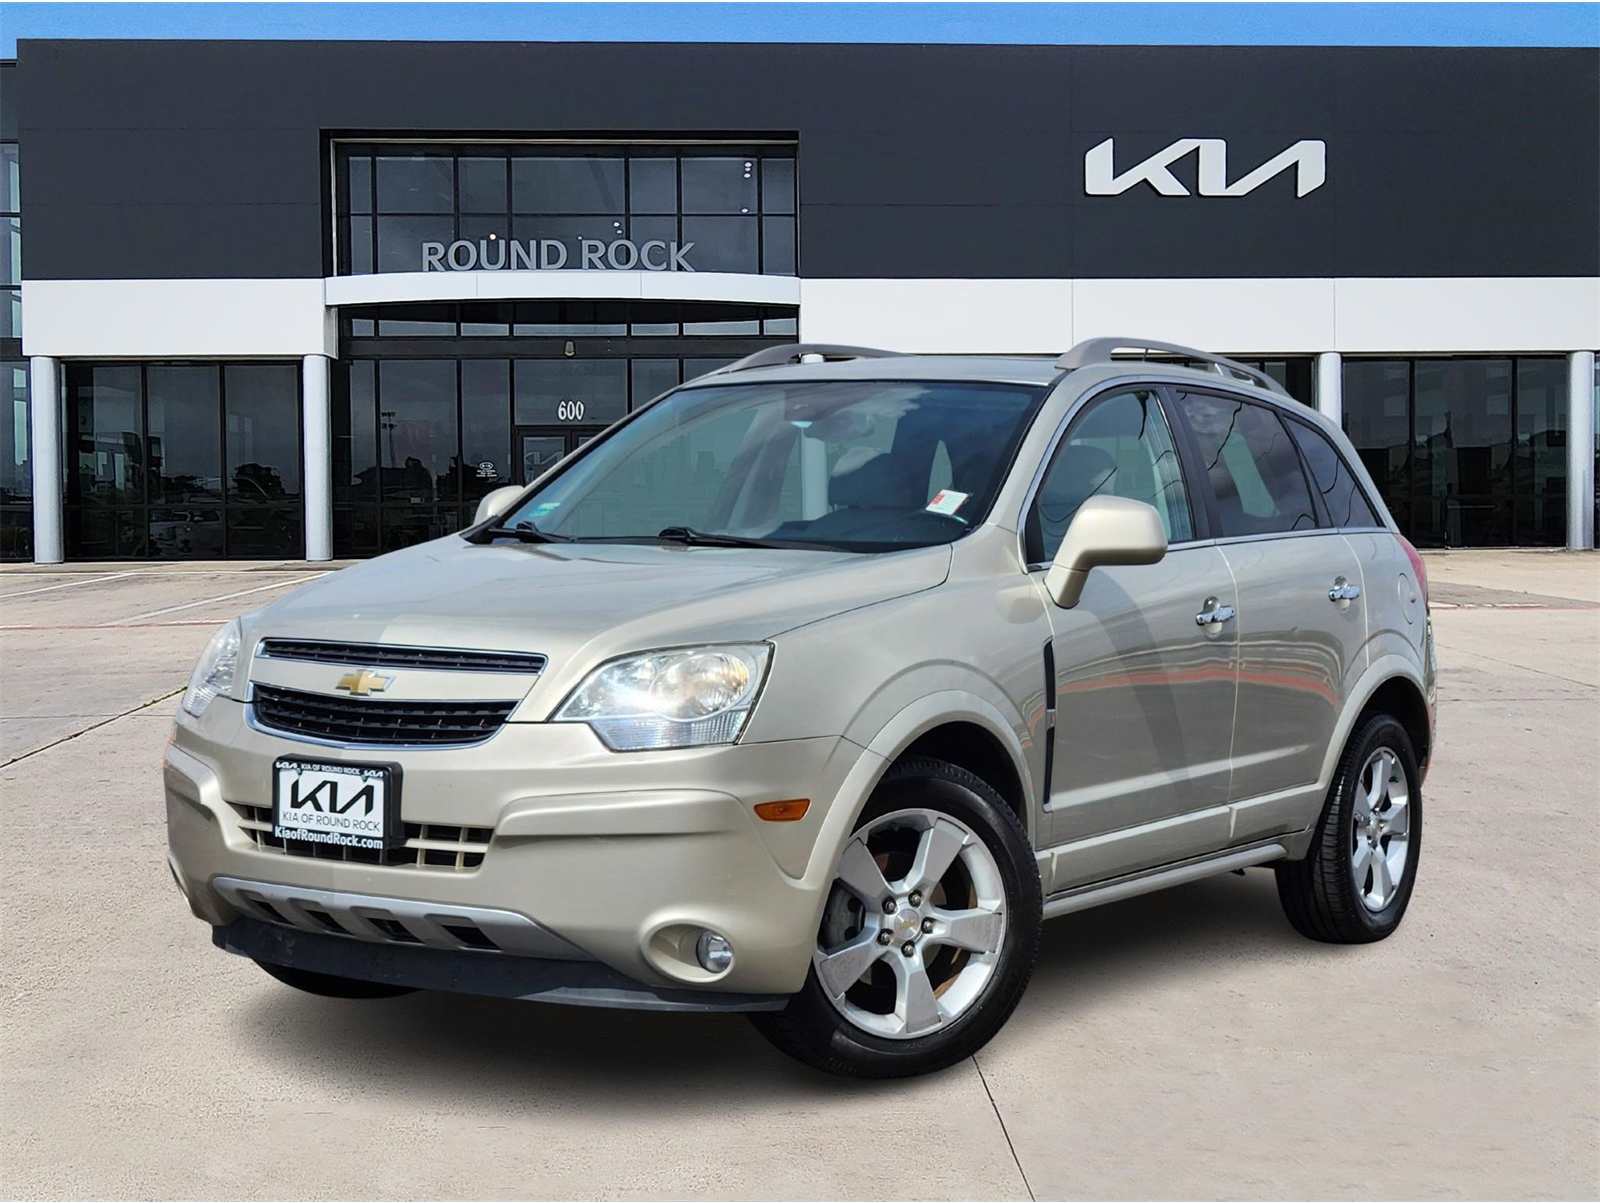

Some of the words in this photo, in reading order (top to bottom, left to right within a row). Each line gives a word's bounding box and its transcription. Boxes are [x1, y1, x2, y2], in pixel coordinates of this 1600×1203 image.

[1085, 137, 1326, 198] KIA
[422, 239, 568, 272] ROUND
[581, 239, 696, 272] ROCK
[558, 400, 584, 420] 600
[321, 765, 343, 774] ROUND
[343, 767, 361, 775] ROCK
[290, 778, 375, 817] KIA
[282, 811, 298, 821] KIA
[301, 813, 314, 824] OF
[316, 815, 351, 828] ROUND
[353, 820, 380, 832] ROCK
[275, 826, 384, 849] KiaofRoundRock.com
